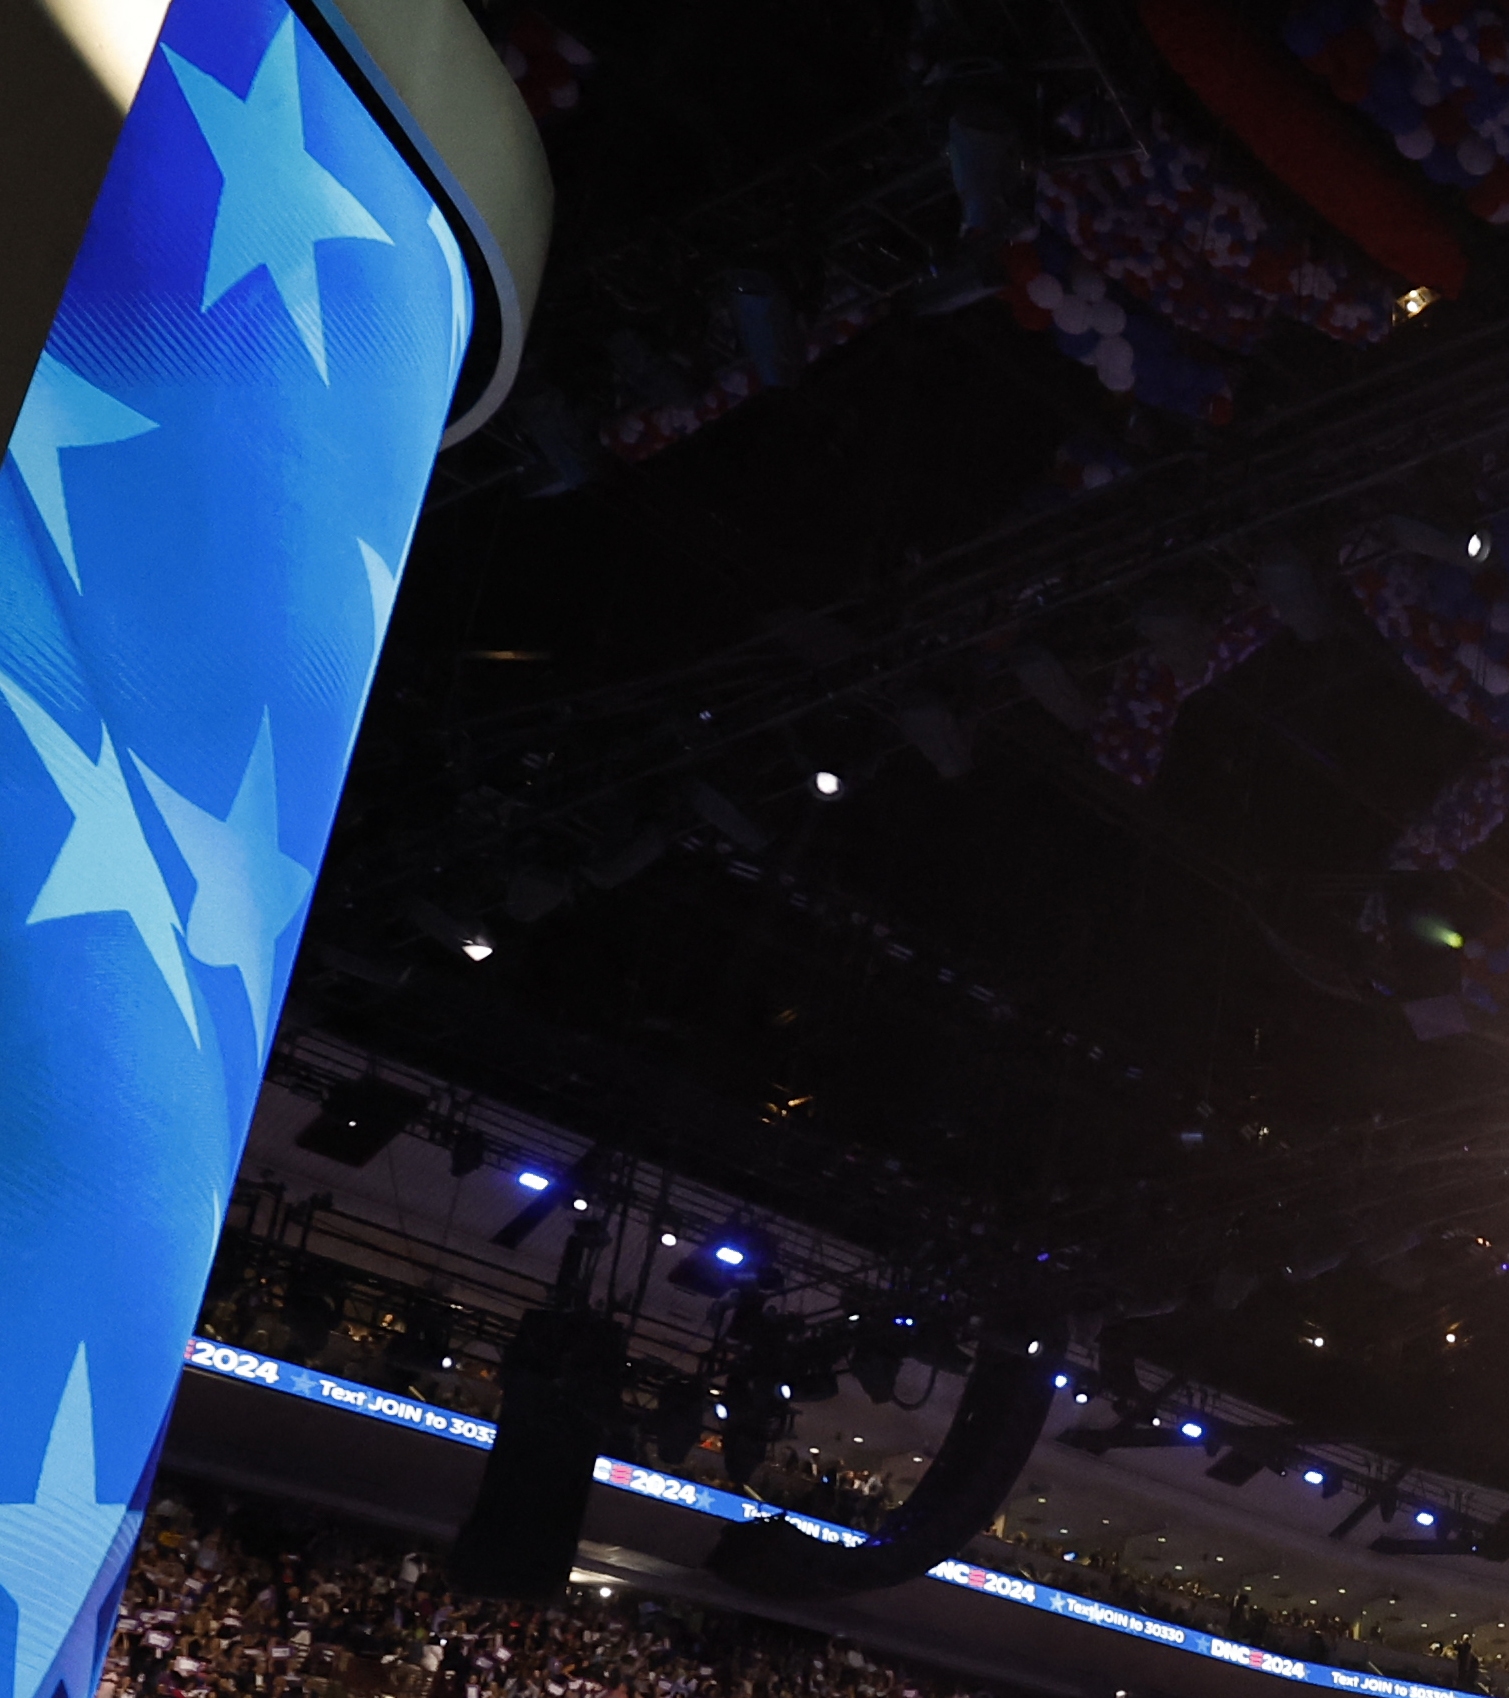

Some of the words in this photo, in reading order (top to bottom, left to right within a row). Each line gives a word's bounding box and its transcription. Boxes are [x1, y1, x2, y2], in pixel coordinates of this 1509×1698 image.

[191, 1342, 279, 1383] 2024
[320, 1380, 367, 1405] Text
[368, 1396, 423, 1422] JOIN
[425, 1412, 447, 1430] to
